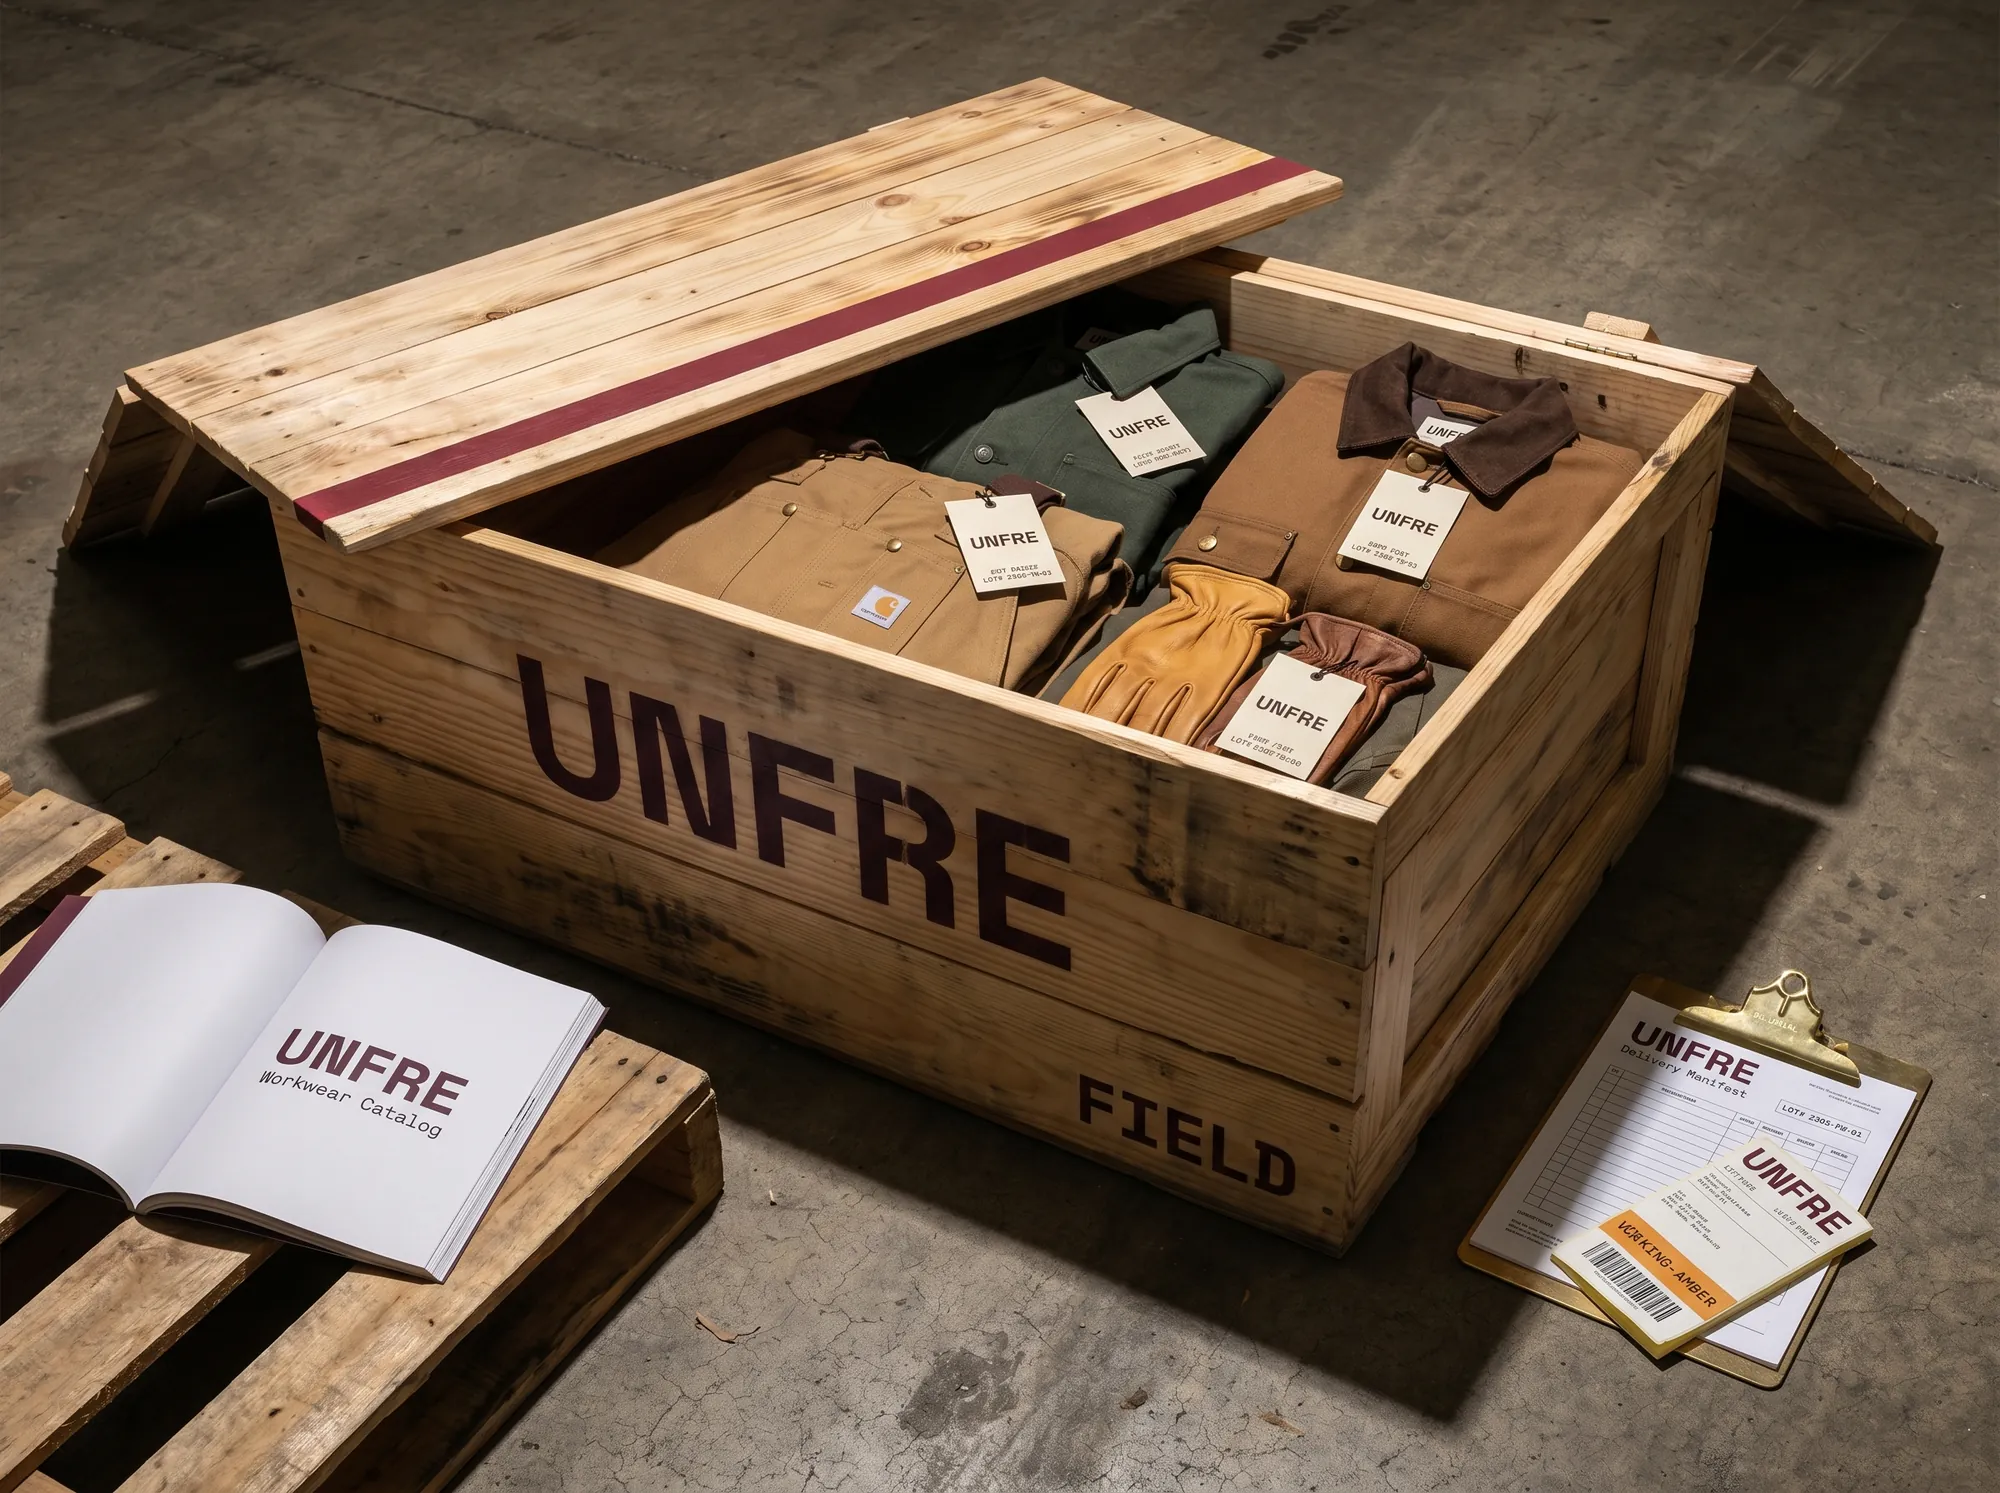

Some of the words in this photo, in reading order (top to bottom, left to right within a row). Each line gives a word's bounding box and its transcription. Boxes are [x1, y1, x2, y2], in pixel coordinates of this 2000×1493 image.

[1108, 415, 1170, 439] UNFRE
[970, 531, 1039, 549] UNFRE
[1372, 507, 1439, 536] UNFRE
[1256, 695, 1328, 732] UNFRE
[516, 653, 1072, 972] UNFRE
[276, 1028, 469, 1116] UNFRE
[1621, 1044, 1682, 1074] Delivery
[1686, 1069, 1748, 1099] Manifest
[1631, 1021, 1760, 1086] UNFRE
[259, 1070, 351, 1103] Workwear
[360, 1097, 443, 1140] Catalog
[1782, 1104, 1806, 1117] LOT#
[1079, 1074, 1297, 1198] FIELD
[1742, 1147, 1853, 1236] UNFRE
